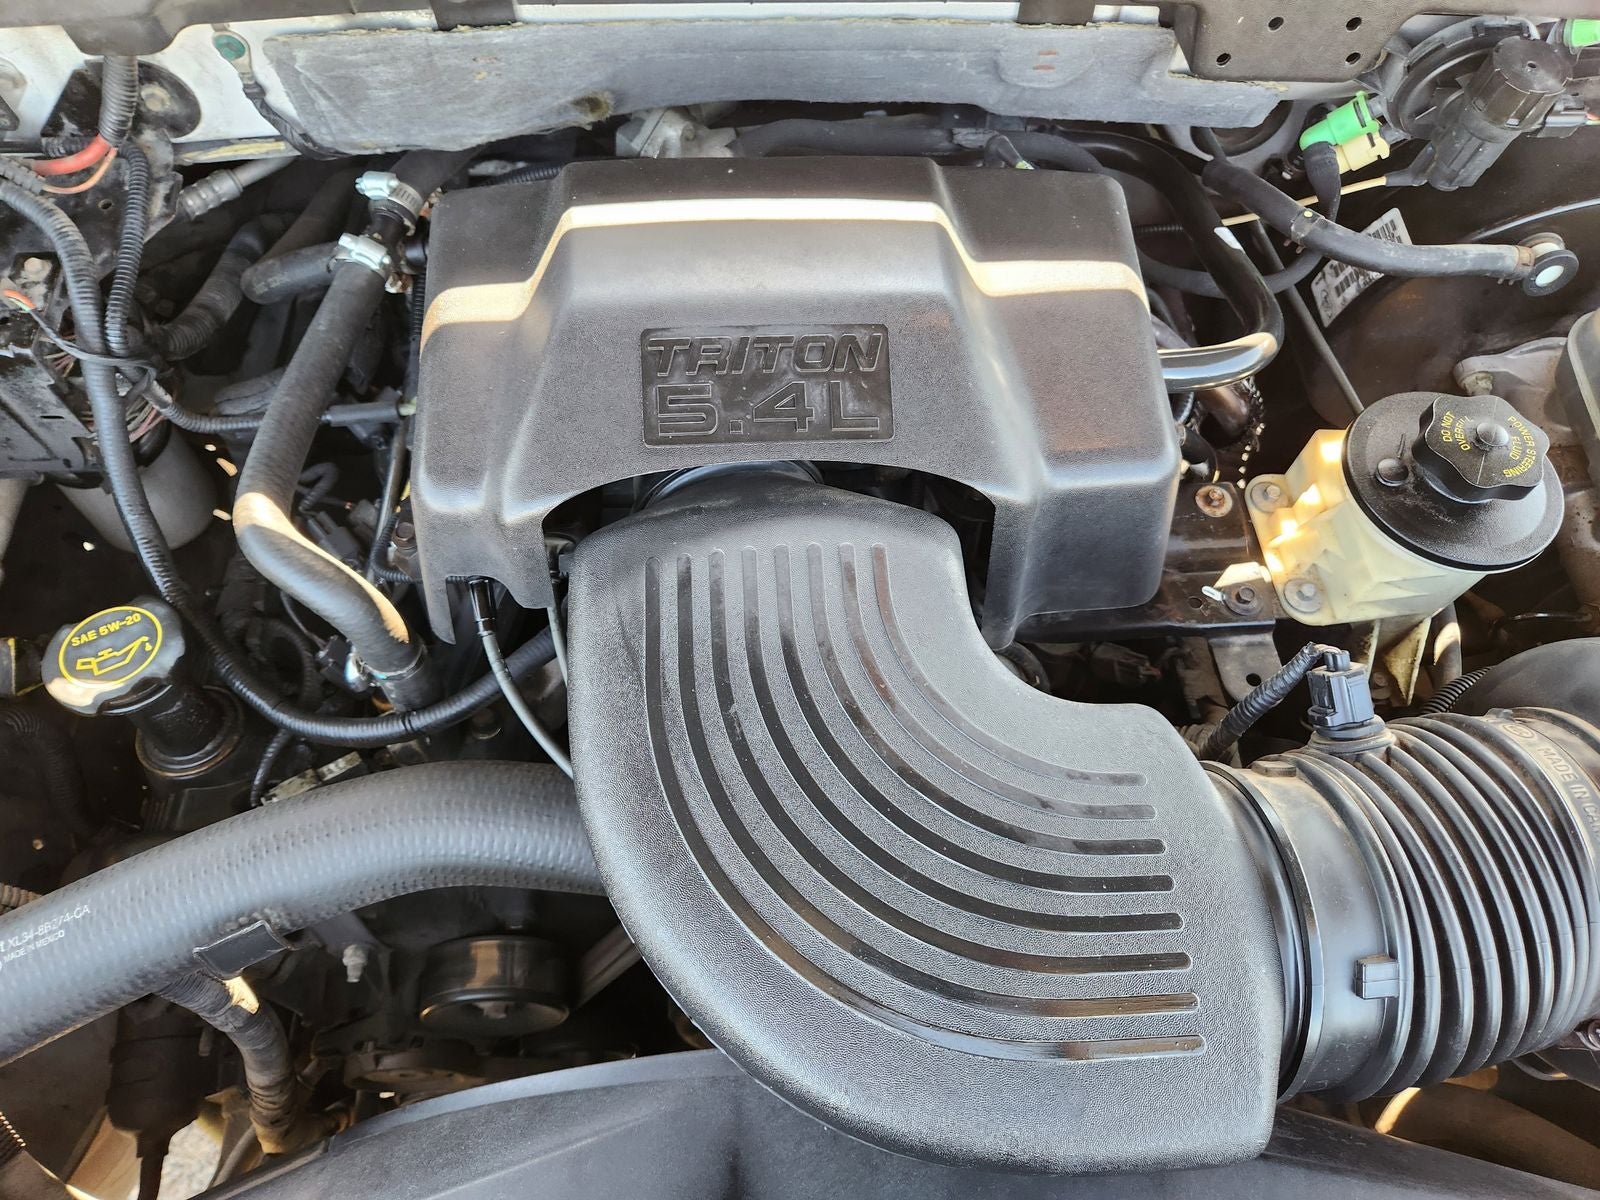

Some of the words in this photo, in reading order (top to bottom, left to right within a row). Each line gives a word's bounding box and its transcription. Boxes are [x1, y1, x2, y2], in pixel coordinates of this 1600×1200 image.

[648, 332, 884, 377] TRITON
[656, 381, 881, 437] 5.4L
[1441, 411, 1455, 428] NOT
[1440, 429, 1453, 442] DO
[1454, 415, 1474, 451] OVERFILL
[1507, 416, 1536, 448] POWER
[1509, 436, 1523, 460] FLUID
[1503, 448, 1538, 478] STEERING
[71, 629, 98, 647] SAE
[98, 612, 142, 636] 5W-20
[1538, 747, 1579, 783] MADE
[1569, 784, 1590, 801] IN
